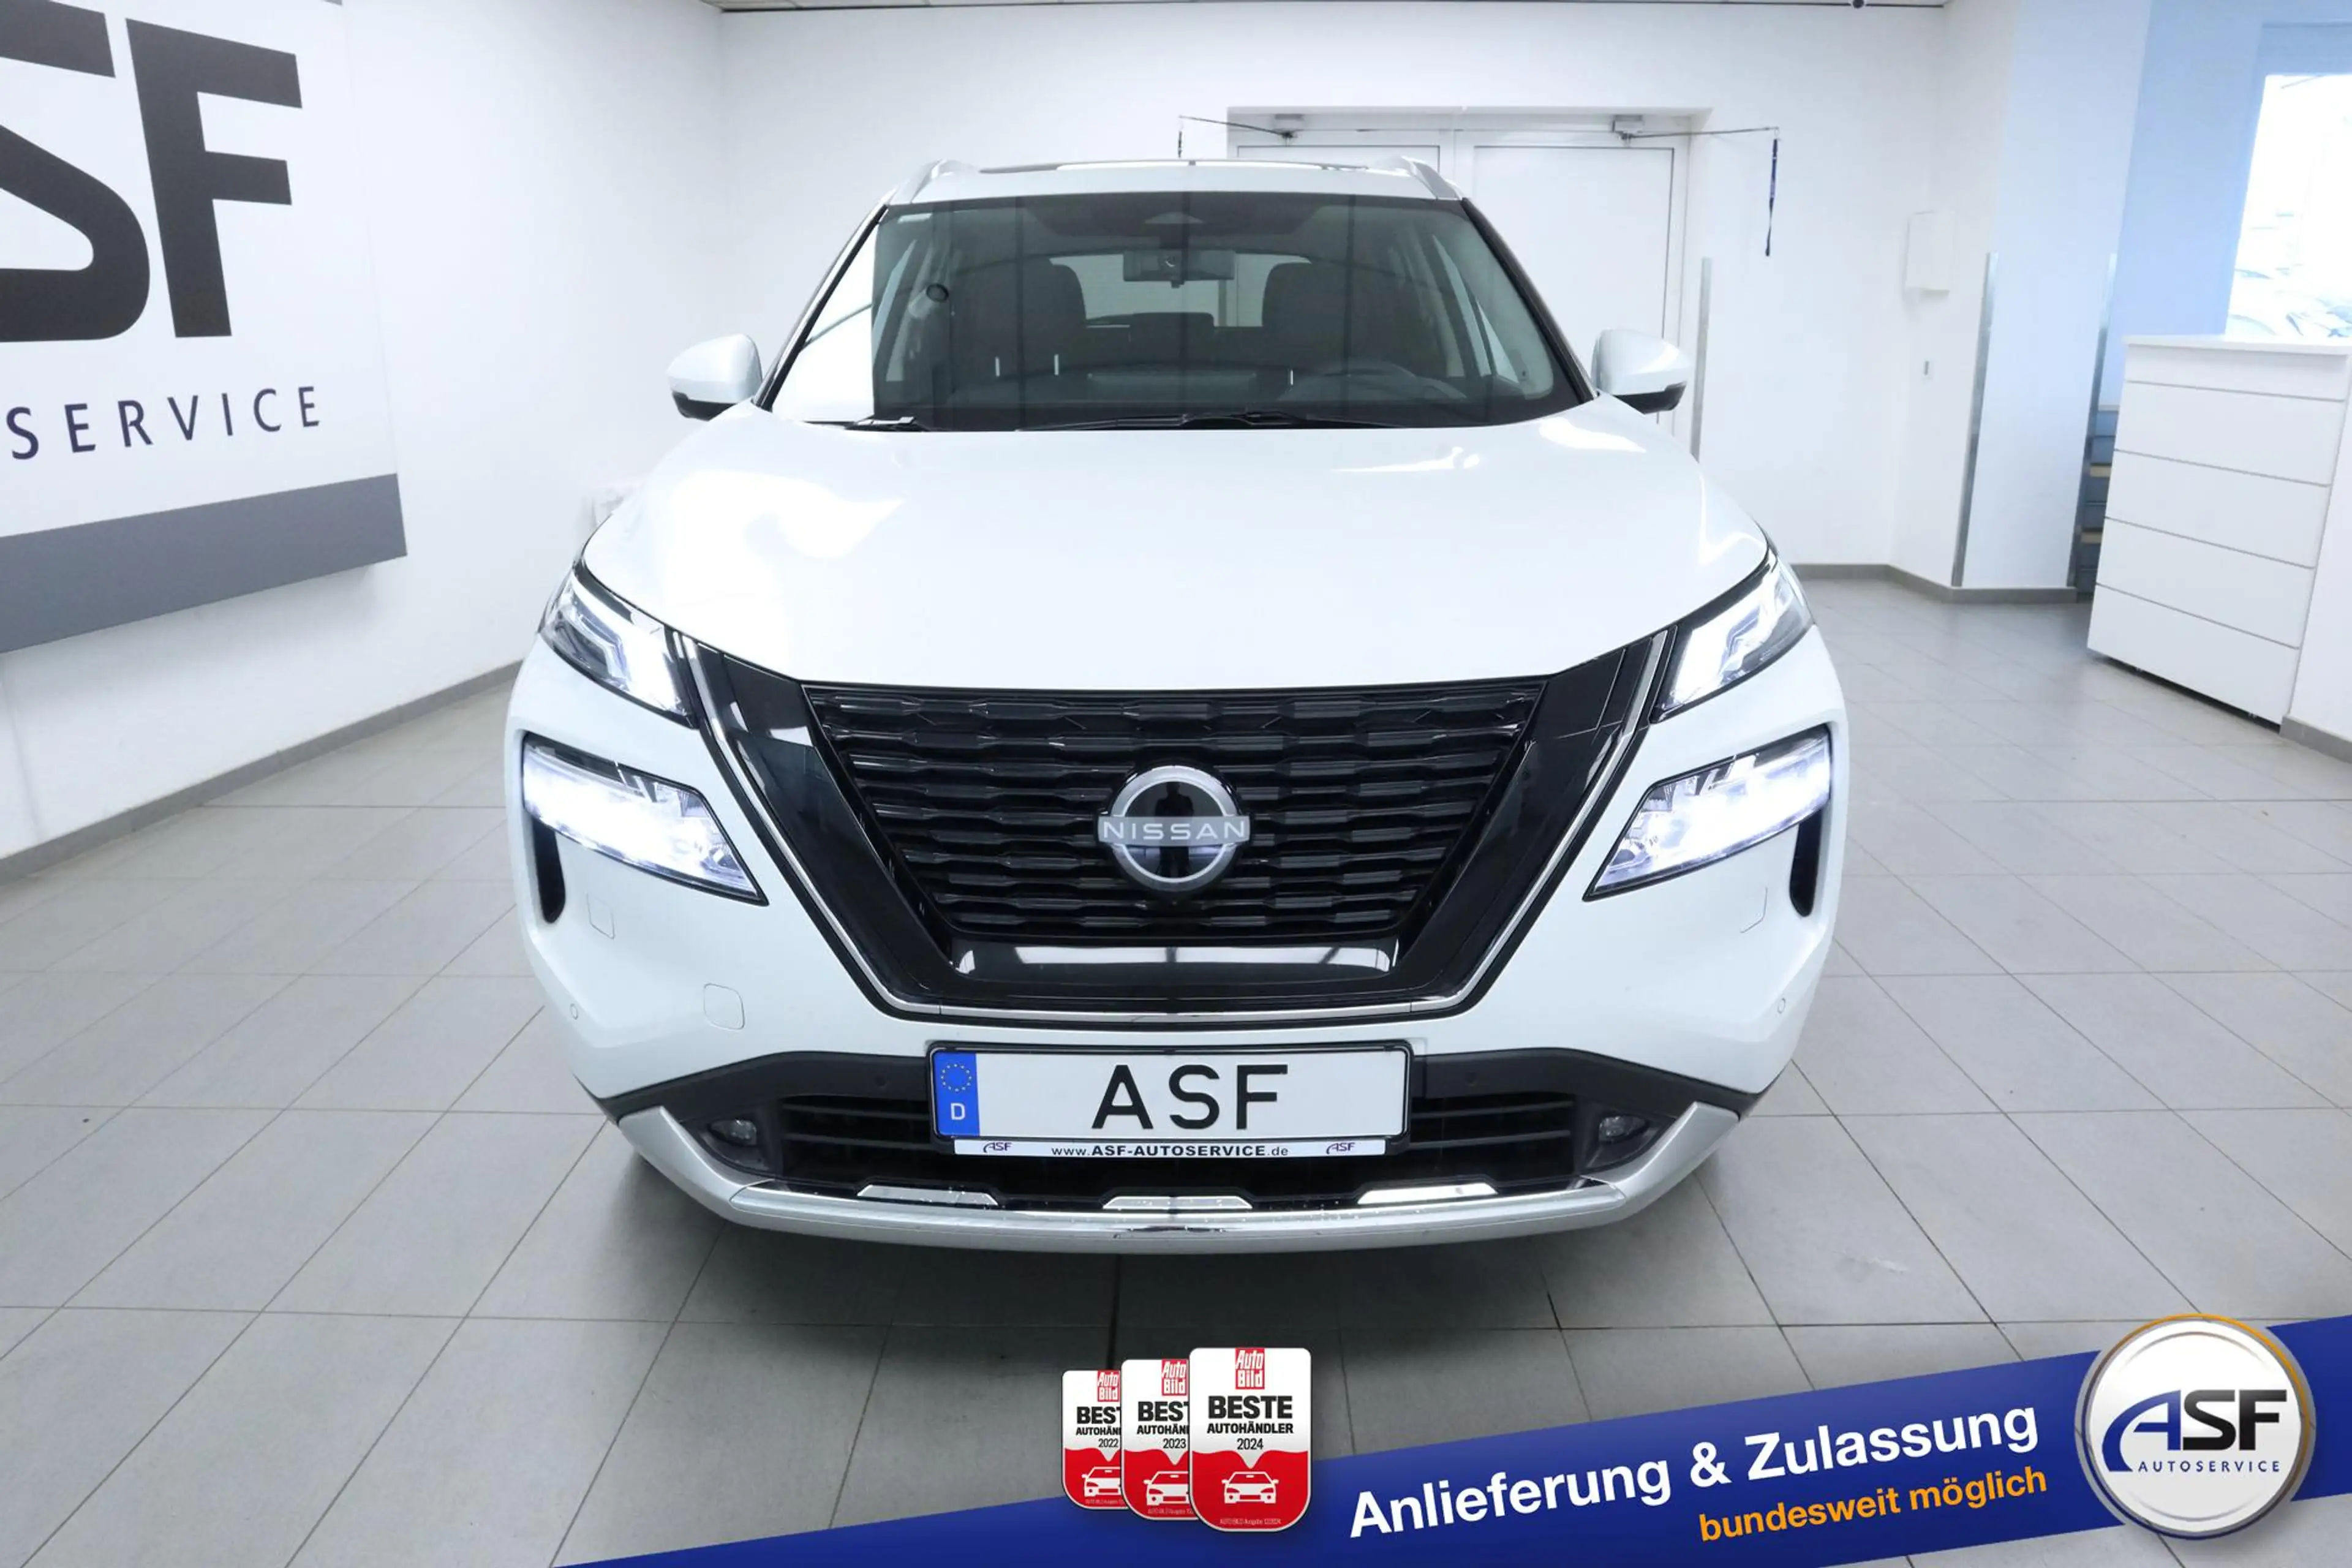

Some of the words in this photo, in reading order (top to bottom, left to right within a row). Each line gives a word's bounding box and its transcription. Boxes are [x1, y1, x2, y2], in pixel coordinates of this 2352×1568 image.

[6, 386, 321, 460] SERVICE
[1103, 821, 1245, 840] NISSAN
[1091, 1064, 1289, 1130] ASF
[951, 1103, 966, 1121] D
[983, 1141, 1012, 1153] ASF
[1051, 1145, 1289, 1157] www.ASF-AUTOSERVICE.de
[1326, 1142, 1355, 1155] ASF
